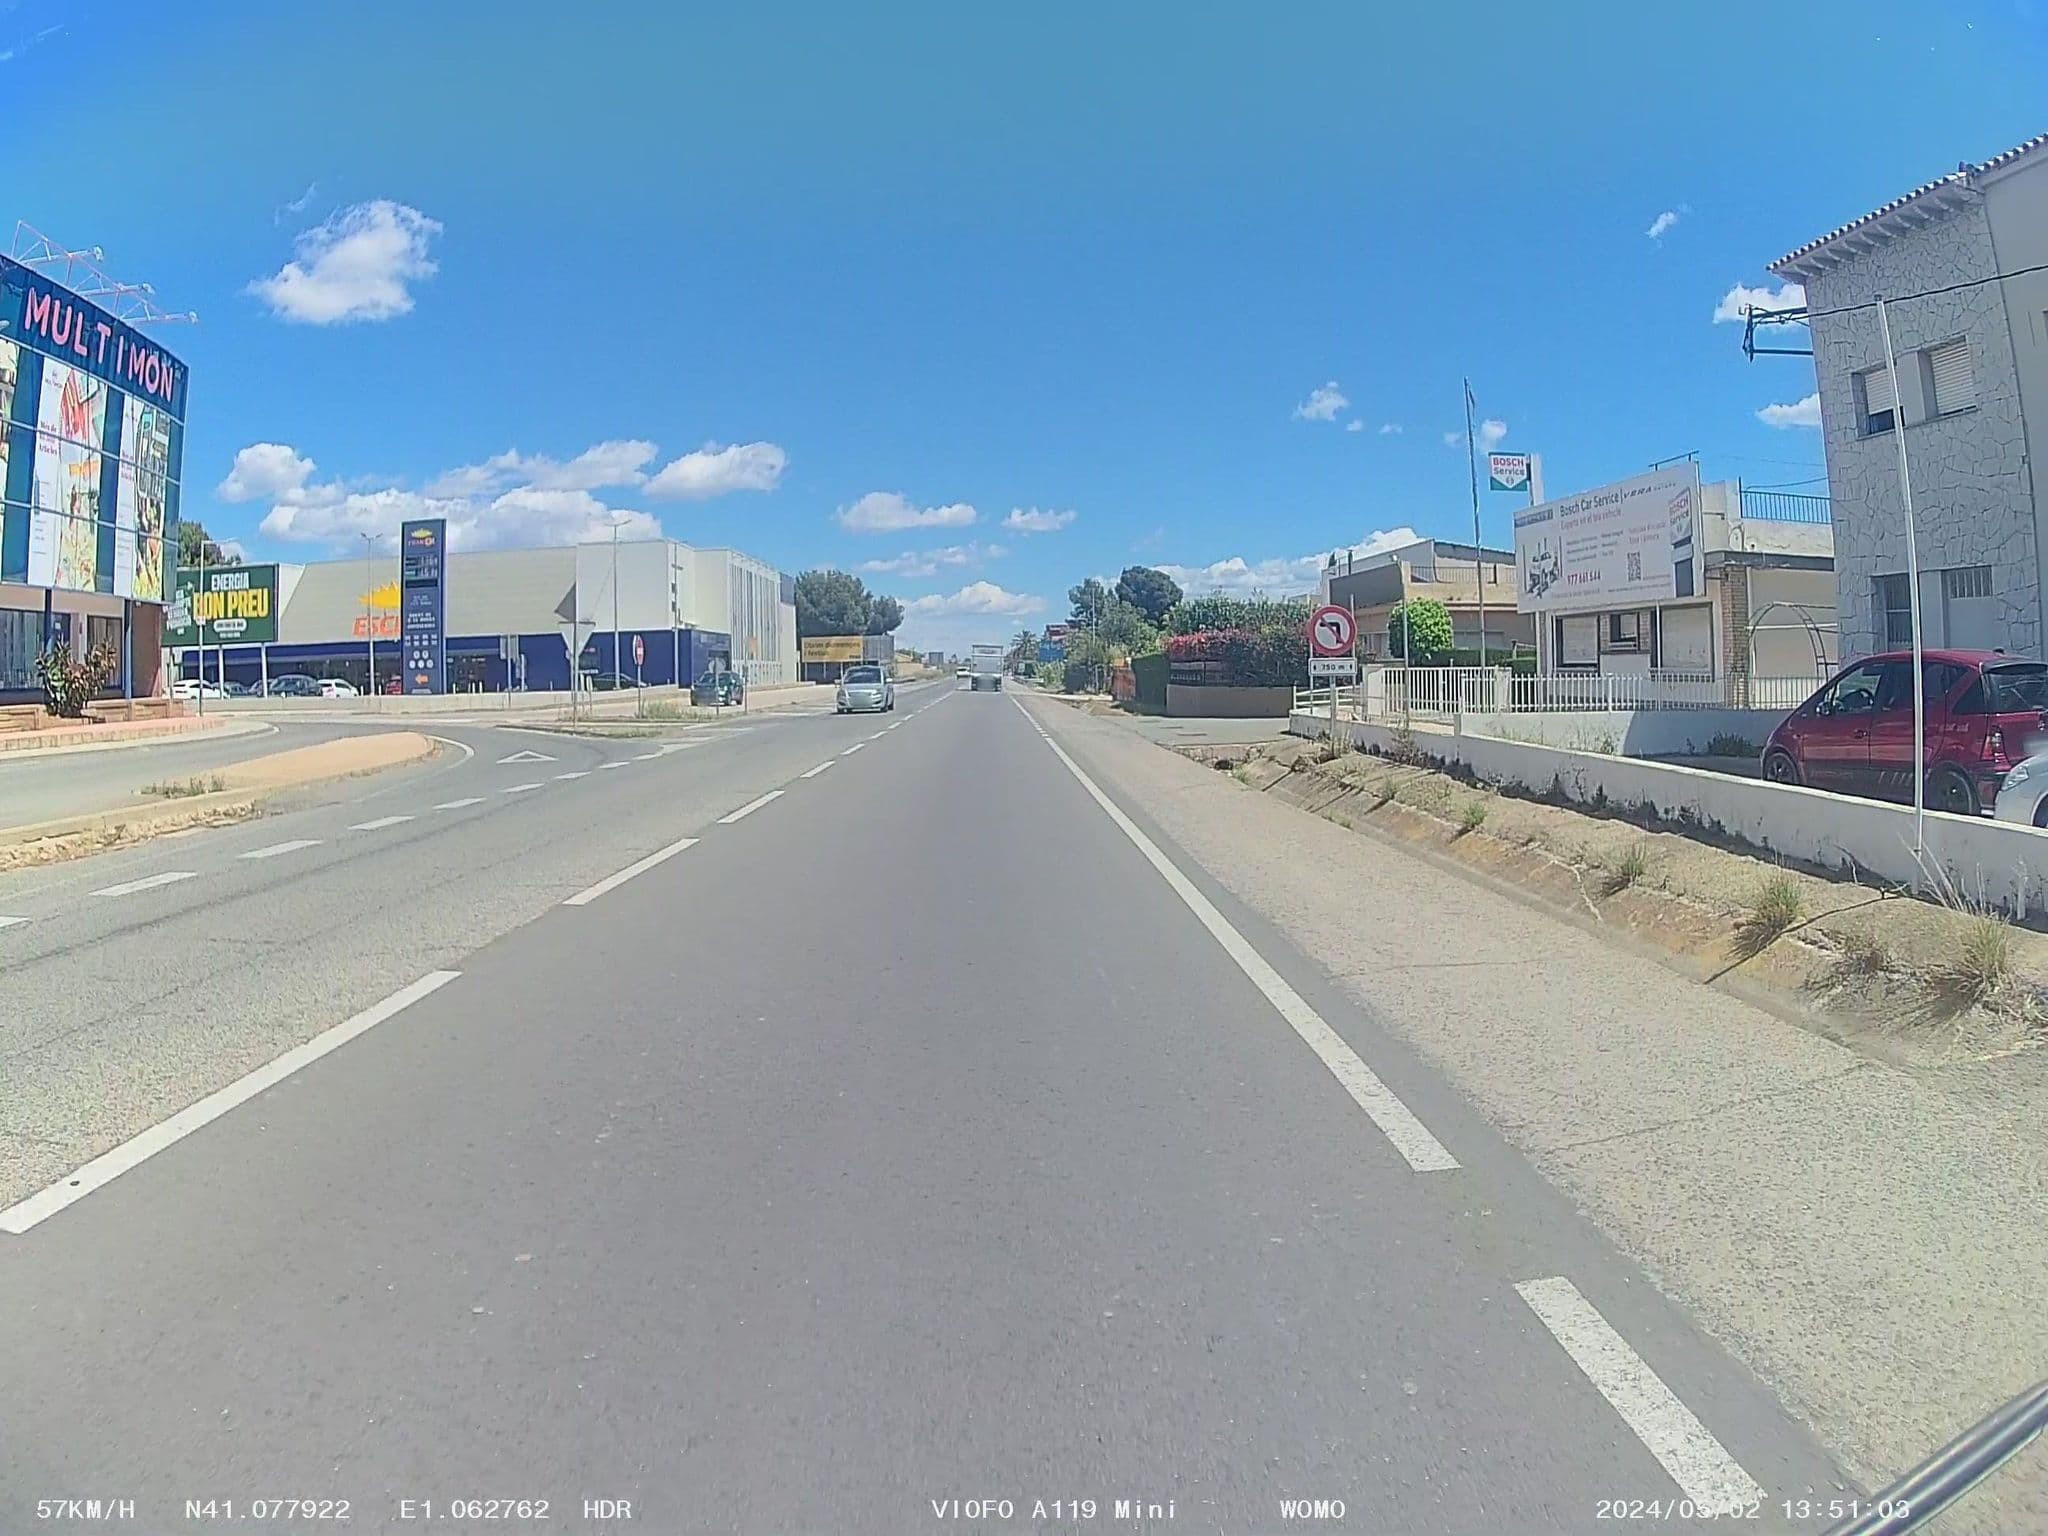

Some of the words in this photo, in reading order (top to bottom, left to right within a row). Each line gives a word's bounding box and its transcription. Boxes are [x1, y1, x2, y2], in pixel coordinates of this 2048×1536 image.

[1493, 457, 1524, 467] BOSCH
[1493, 467, 1525, 476] Service
[1560, 500, 1580, 517] Bosch
[1580, 499, 1592, 511] Car
[1594, 492, 1619, 508] Service
[227, 588, 269, 618] PREU
